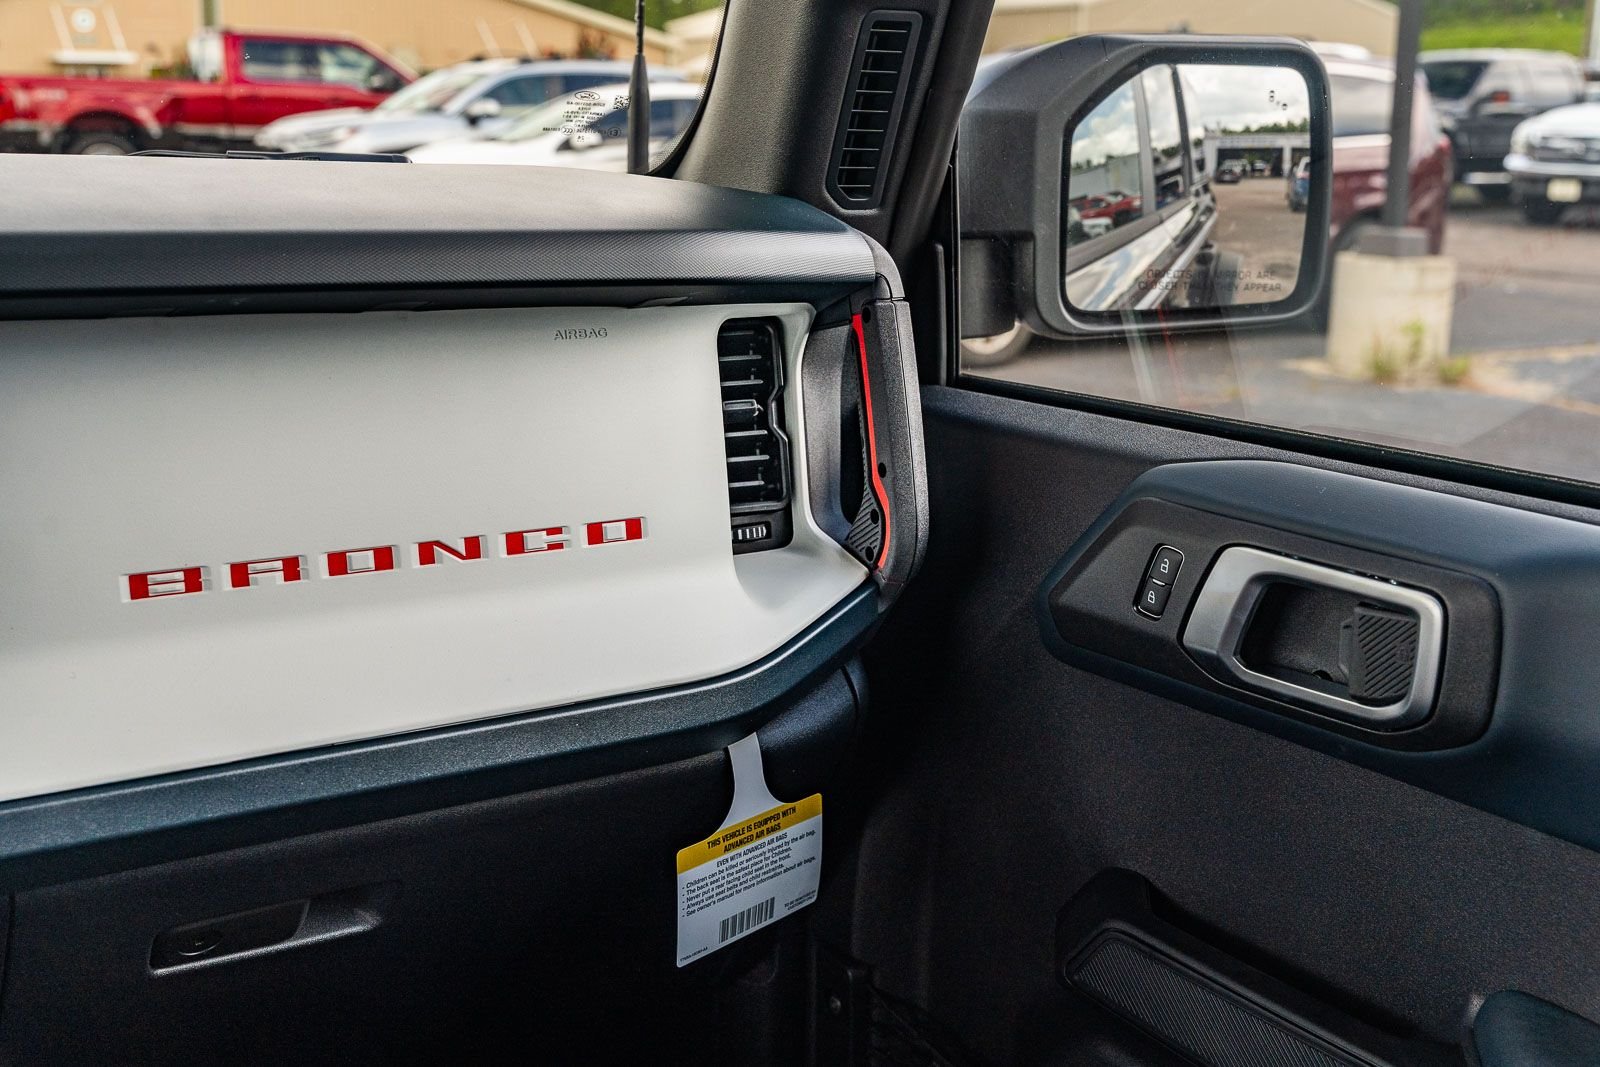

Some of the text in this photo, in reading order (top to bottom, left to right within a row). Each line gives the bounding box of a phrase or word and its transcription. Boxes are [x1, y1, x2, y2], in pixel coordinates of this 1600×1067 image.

[1138, 282, 1177, 292] CLOSER
[1244, 282, 1282, 292] APPEAR
[1147, 270, 1192, 279] OBJECTS
[1216, 270, 1252, 280] MIRROR
[1257, 270, 1275, 279] ARE
[554, 328, 608, 340] AIRBAG
[120, 517, 647, 602] BRONCO
[707, 806, 796, 849] THIS VEHICLE IS EQUIPPED WITH
[724, 823, 781, 853] ADVANCED AIR BAGS
[686, 877, 707, 888] Children
[708, 872, 717, 880] can
[726, 863, 738, 871] killed
[746, 851, 766, 863] seriously
[768, 842, 784, 853] injured
[717, 833, 788, 867] EVEN WITH ADVANCED AIR BAGS
[687, 893, 701, 903] Never
[702, 888, 710, 897] put
[726, 876, 741, 885] facing
[742, 870, 753, 878] child
[754, 865, 764, 873] seat
[687, 899, 704, 909] Always
[715, 889, 725, 897] seat
[727, 884, 738, 892] belts
[749, 873, 760, 881] child
[697, 882, 709, 891] back
[710, 877, 720, 886] seat
[735, 864, 749, 874] safest
[751, 859, 763, 868] place
[697, 900, 716, 912] owner's
[717, 891, 734, 903] manual
[743, 883, 755, 891] more
[756, 871, 782, 885] information
[783, 864, 796, 873] about
